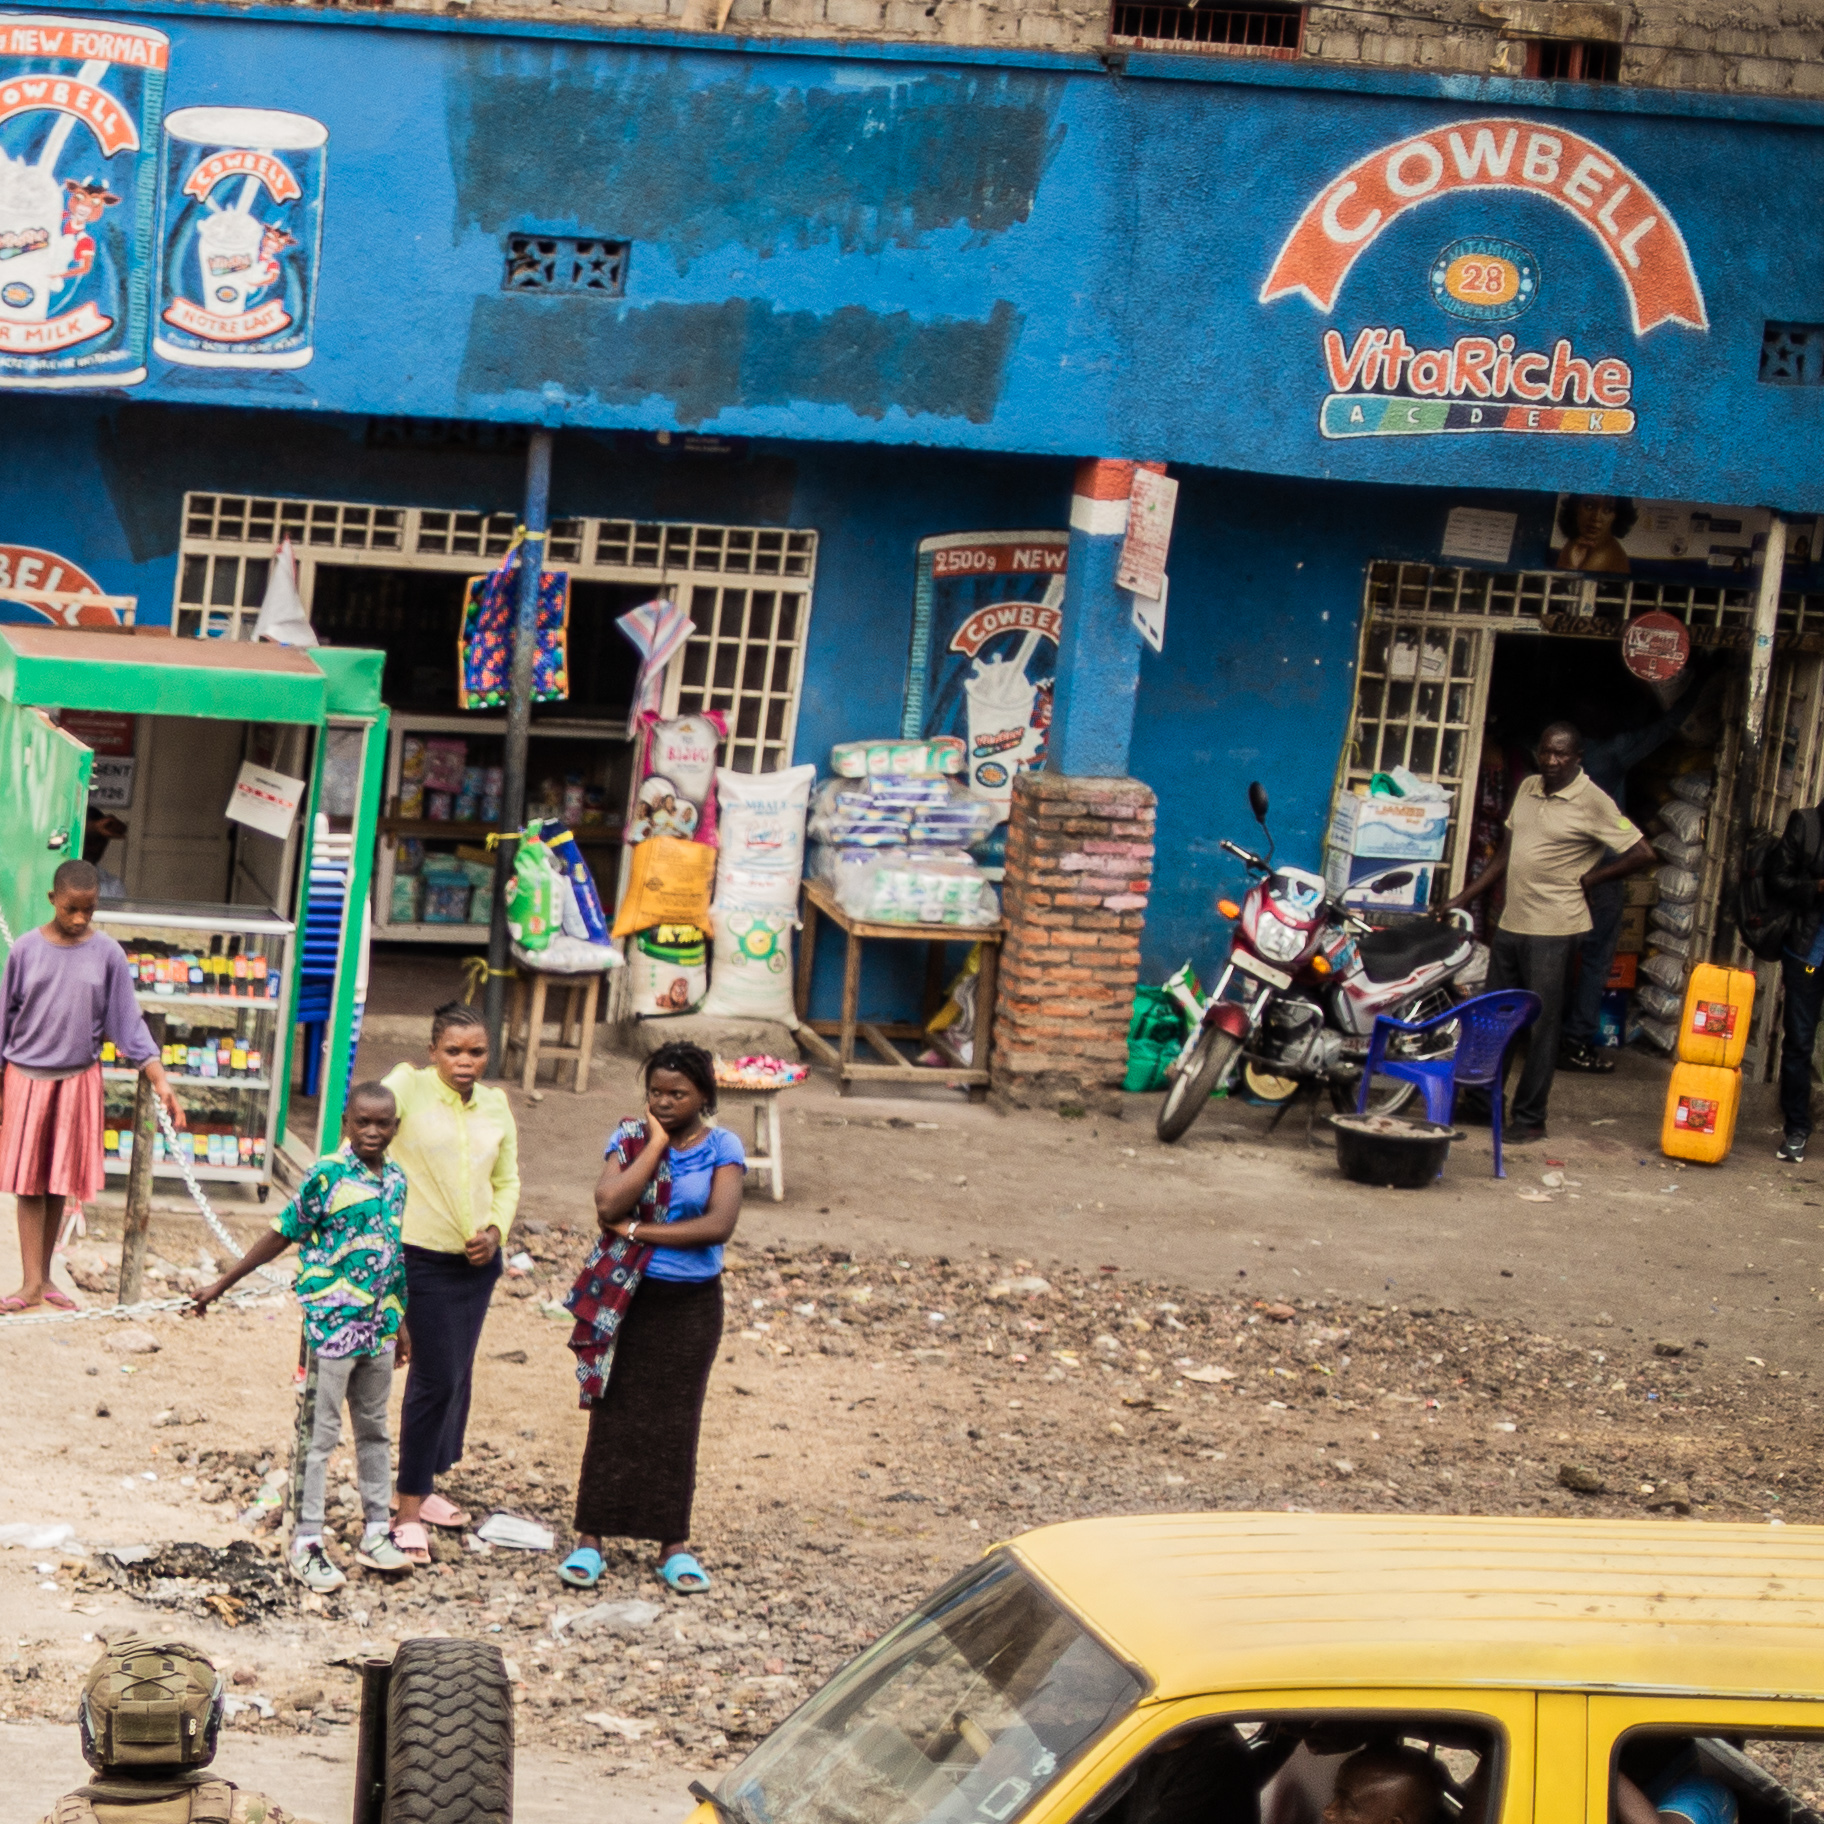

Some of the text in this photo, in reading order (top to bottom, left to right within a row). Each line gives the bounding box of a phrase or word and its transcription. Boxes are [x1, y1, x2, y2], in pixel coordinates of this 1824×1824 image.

[12, 29, 66, 52] NEW
[72, 32, 163, 66] FORMAT
[196, 154, 286, 189] COWBELL
[1321, 127, 1658, 269] COWBELL
[1459, 262, 1505, 295] 28
[25, 312, 83, 344] MILK
[182, 308, 276, 333] NOTRE LAIT
[1323, 327, 1633, 407] VitaRiche
[1350, 405, 1605, 431] A C D E K
[934, 549, 1066, 572] 2500g NEW
[966, 607, 1063, 642] COWBEL
